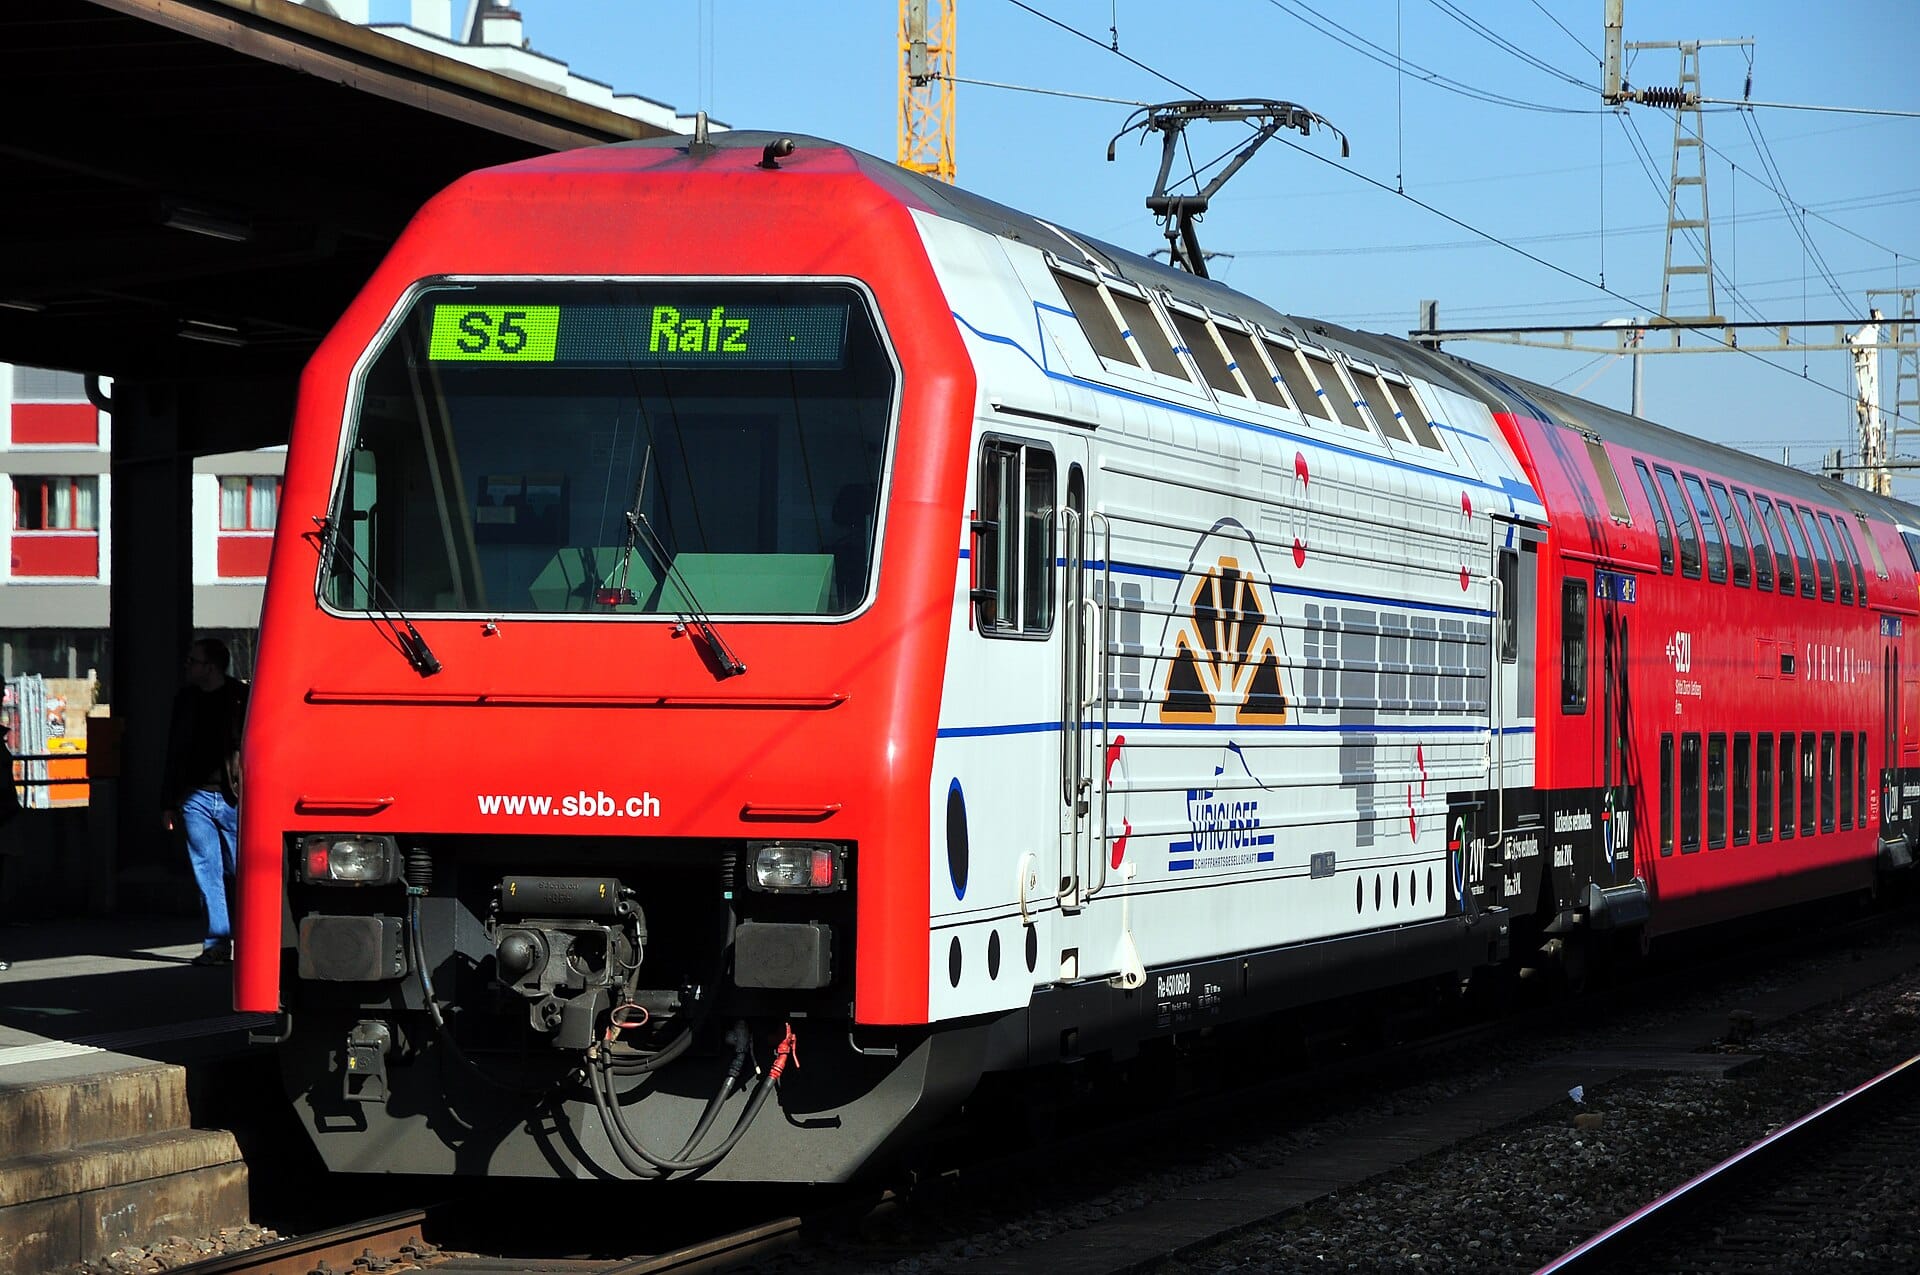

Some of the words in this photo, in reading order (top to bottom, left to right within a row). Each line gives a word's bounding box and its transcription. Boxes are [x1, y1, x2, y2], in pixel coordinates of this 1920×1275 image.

[457, 311, 527, 354] S5
[649, 306, 750, 352] Rafz
[1675, 631, 1691, 673] SZU
[1806, 643, 1855, 683] SIHLTAL
[477, 791, 661, 817] www.sbb.ch
